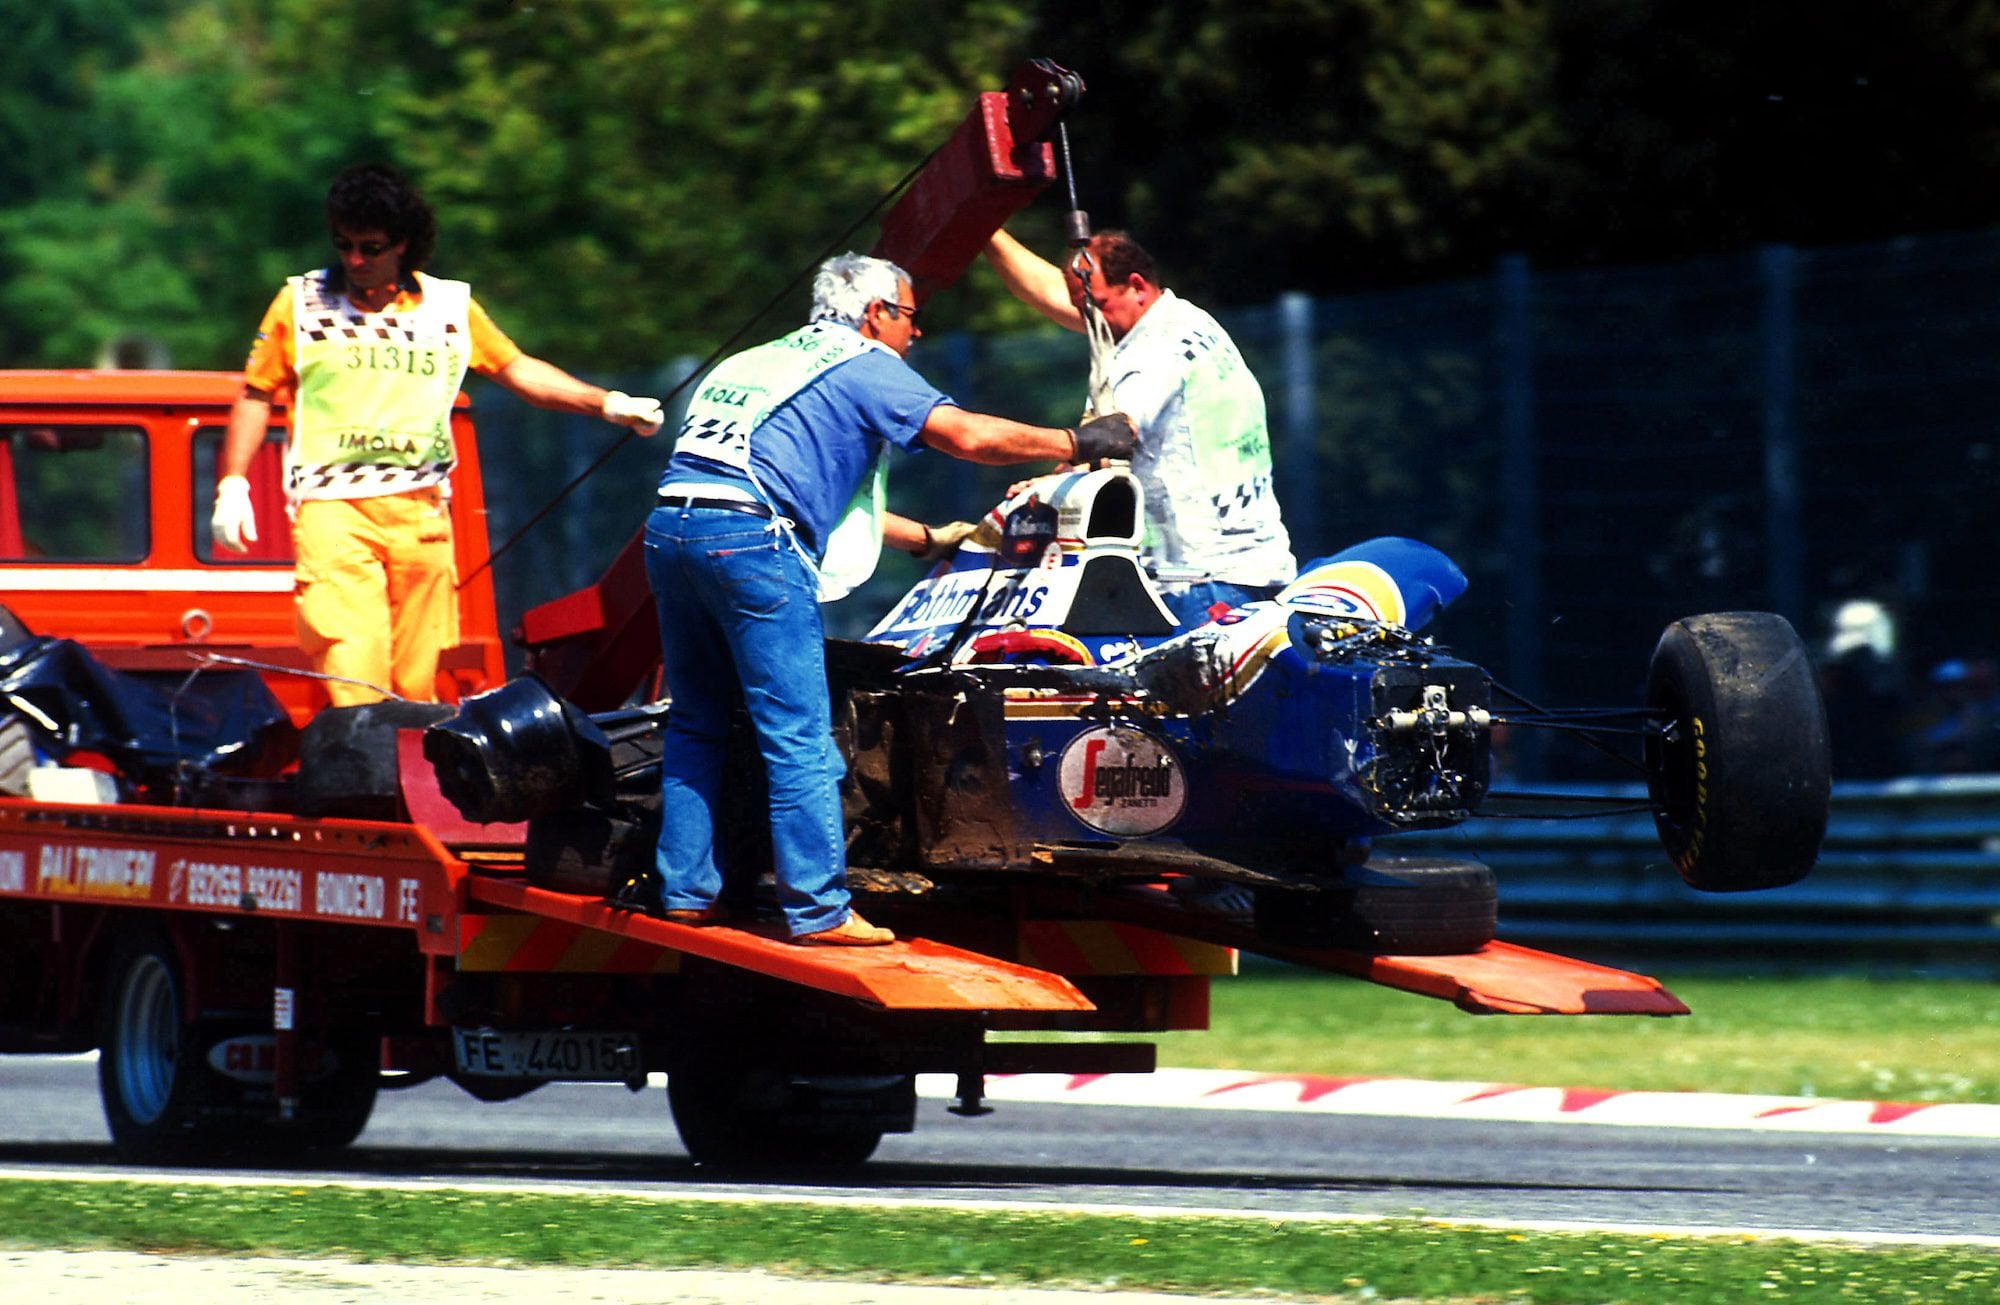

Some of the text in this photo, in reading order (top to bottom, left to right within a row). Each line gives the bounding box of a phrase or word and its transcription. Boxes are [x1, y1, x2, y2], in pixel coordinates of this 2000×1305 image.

[346, 346, 436, 376] 31315
[338, 434, 417, 454] IMOLA
[1073, 739, 1171, 809] Segafredo
[316, 871, 385, 919] BONDENO
[399, 878, 420, 922] FE
[464, 1035, 637, 1073] FE 440150
